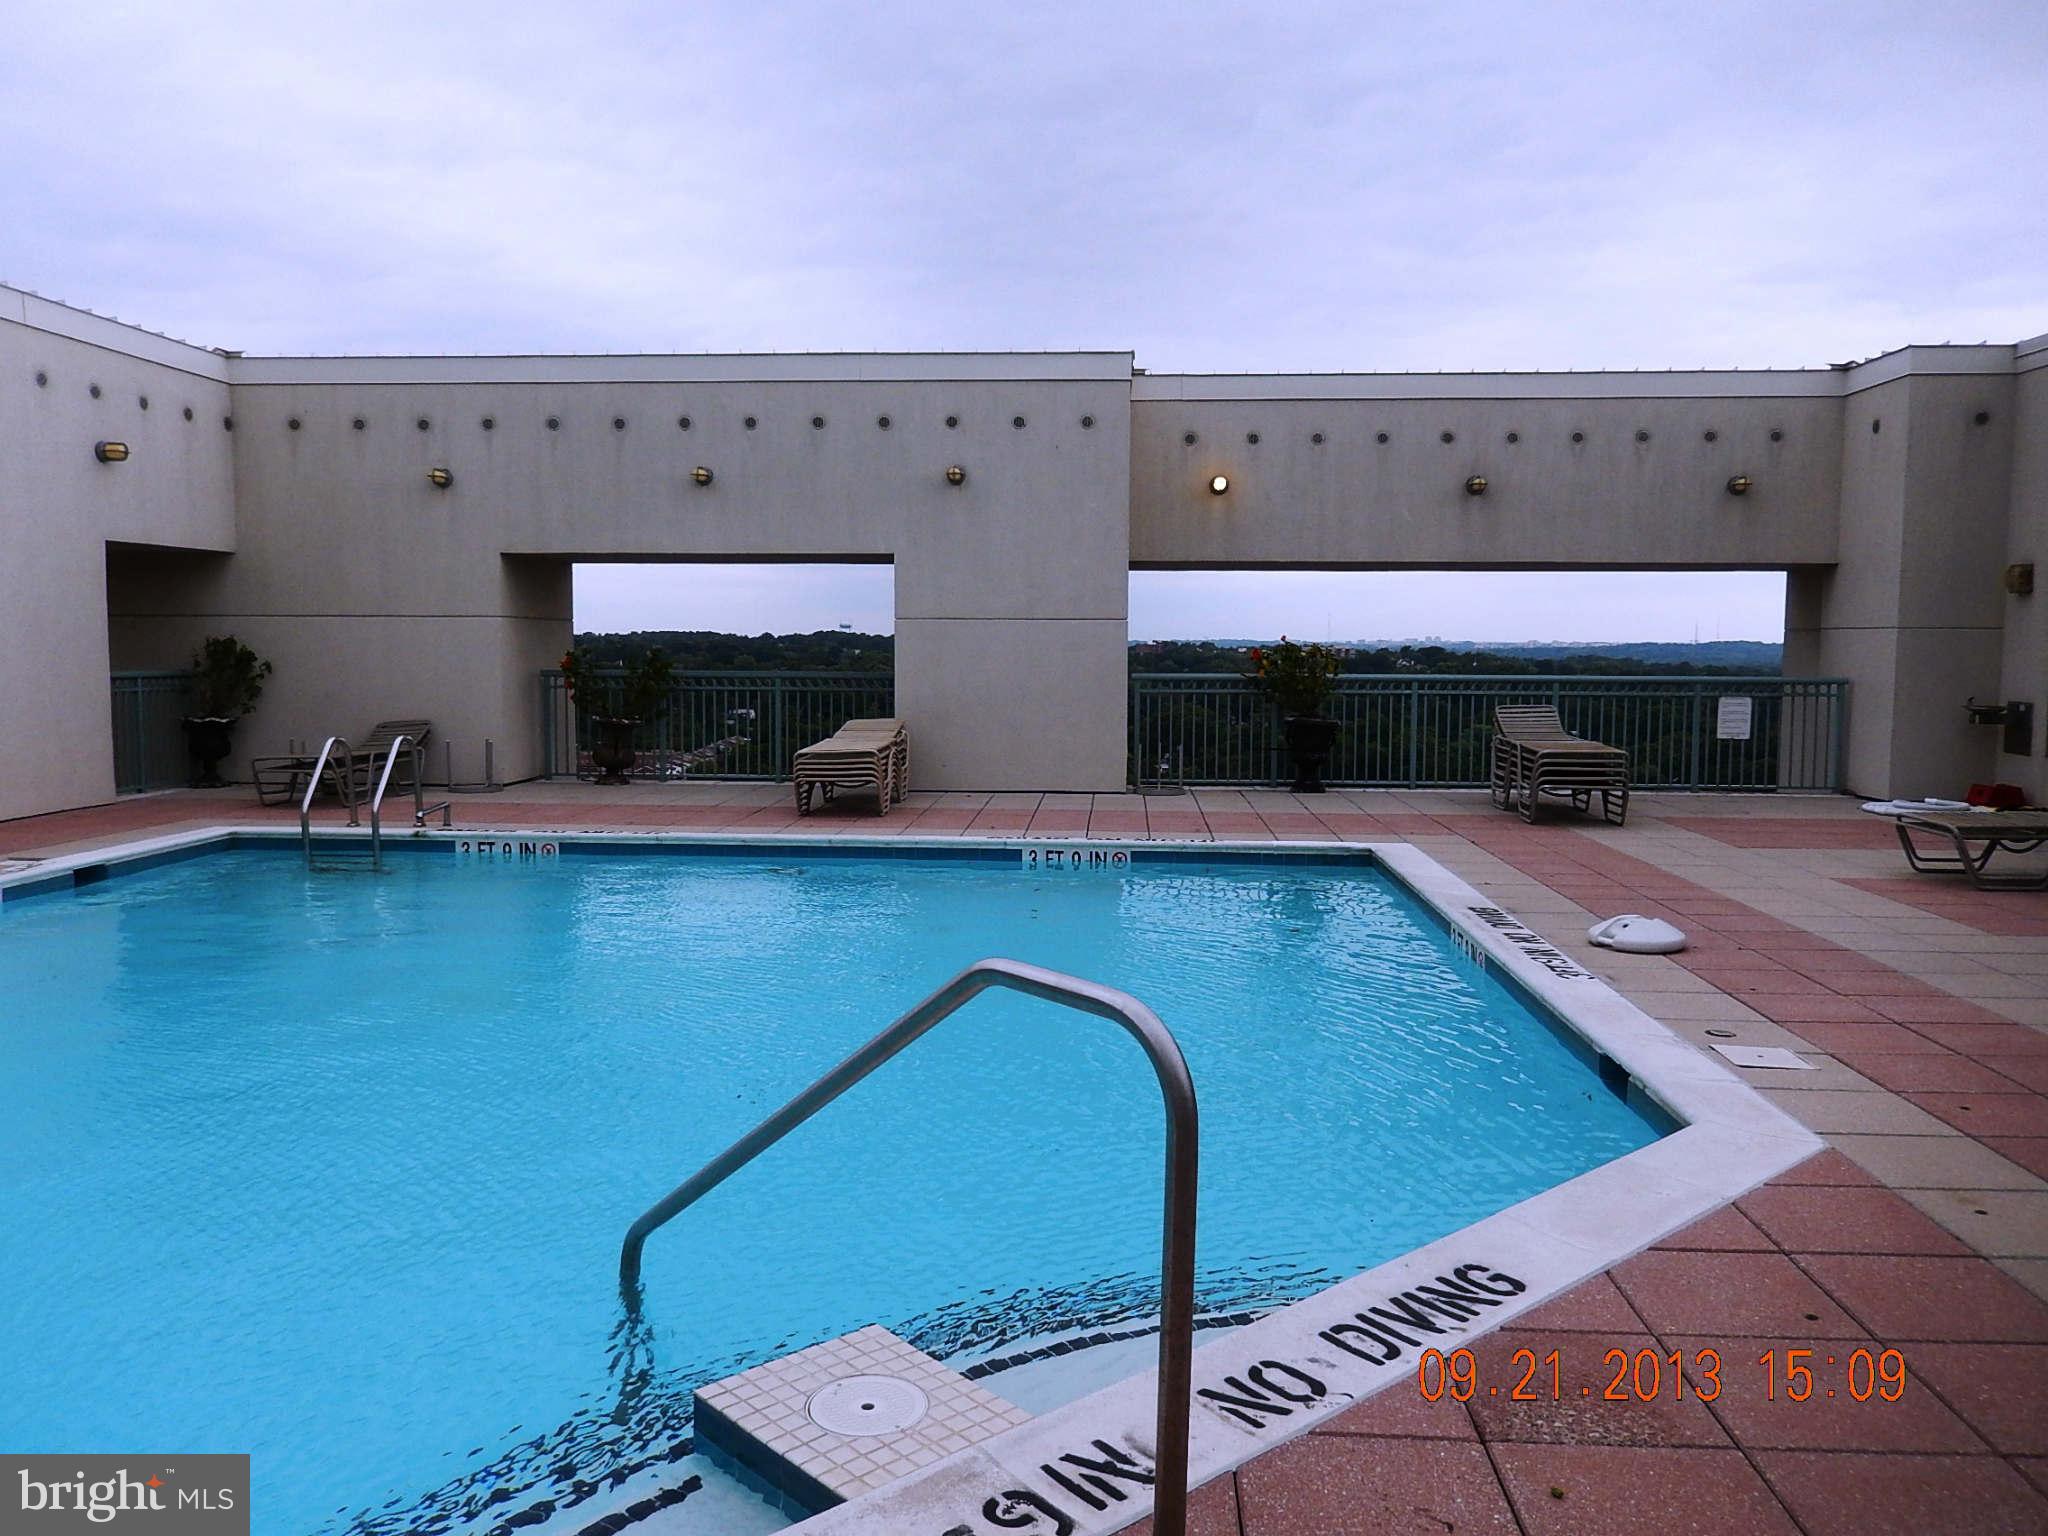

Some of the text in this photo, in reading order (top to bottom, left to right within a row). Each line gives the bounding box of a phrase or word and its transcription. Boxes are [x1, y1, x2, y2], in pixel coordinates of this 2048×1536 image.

[477, 841, 496, 854] FT
[518, 842, 537, 856] IN
[1045, 849, 1065, 862] FT
[1196, 1360, 1328, 1429] NO
[1318, 1263, 1527, 1367] DIVING
